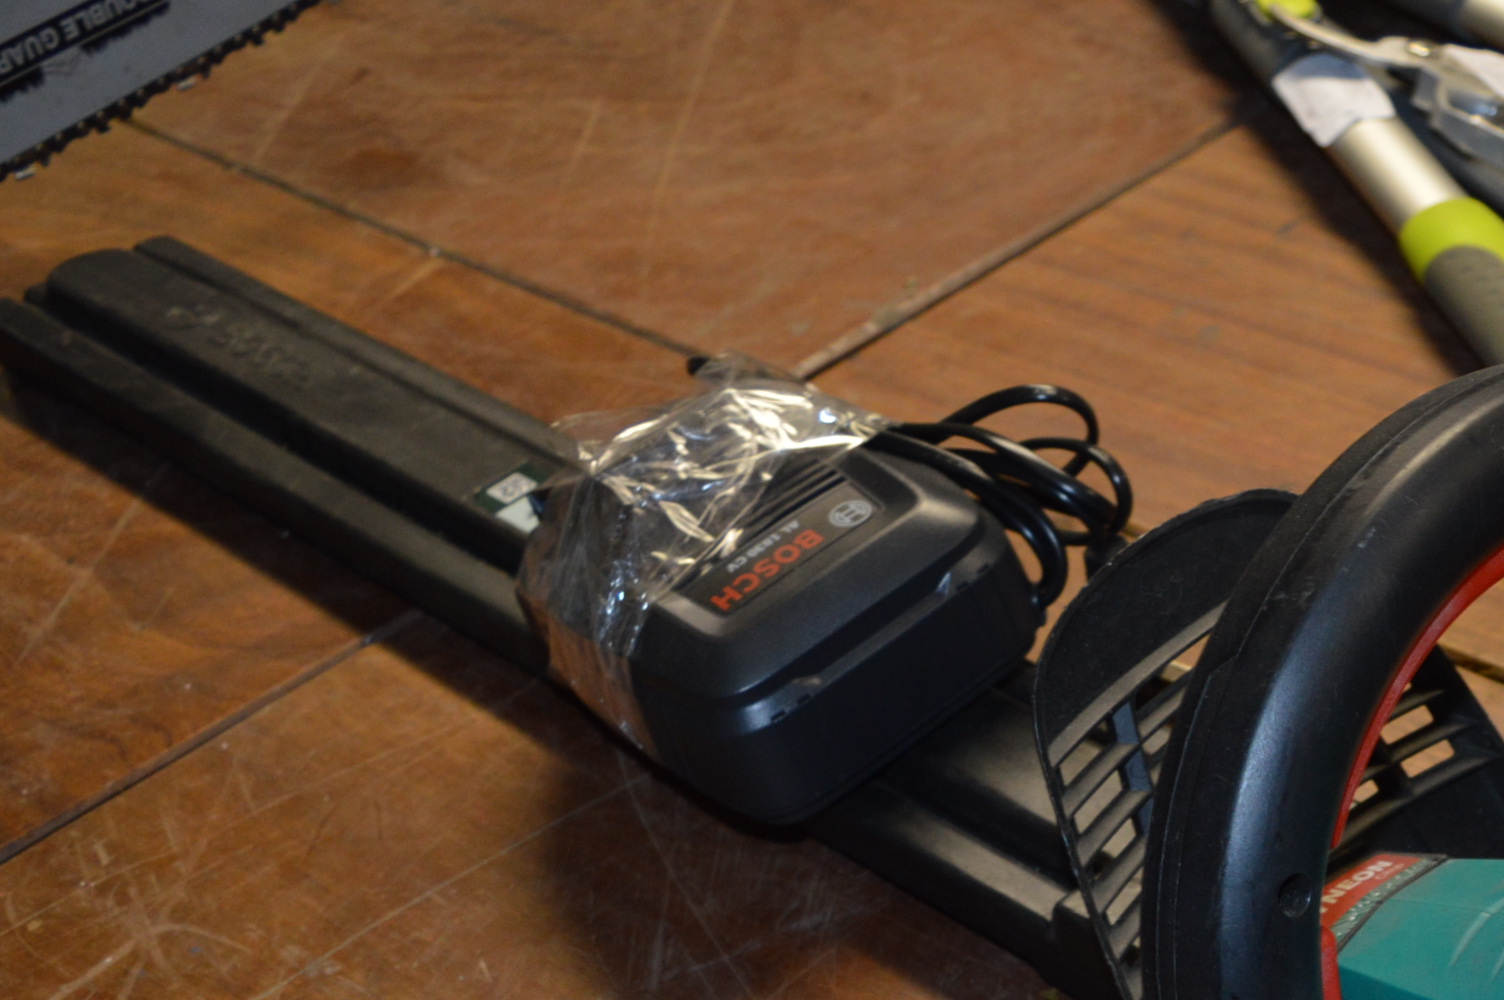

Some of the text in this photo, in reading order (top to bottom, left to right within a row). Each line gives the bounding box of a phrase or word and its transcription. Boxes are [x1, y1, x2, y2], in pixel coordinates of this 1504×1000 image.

[0, 0, 138, 75] OUBLE GUAR
[710, 529, 824, 610] BOSCH
[1320, 860, 1393, 913] NEON
